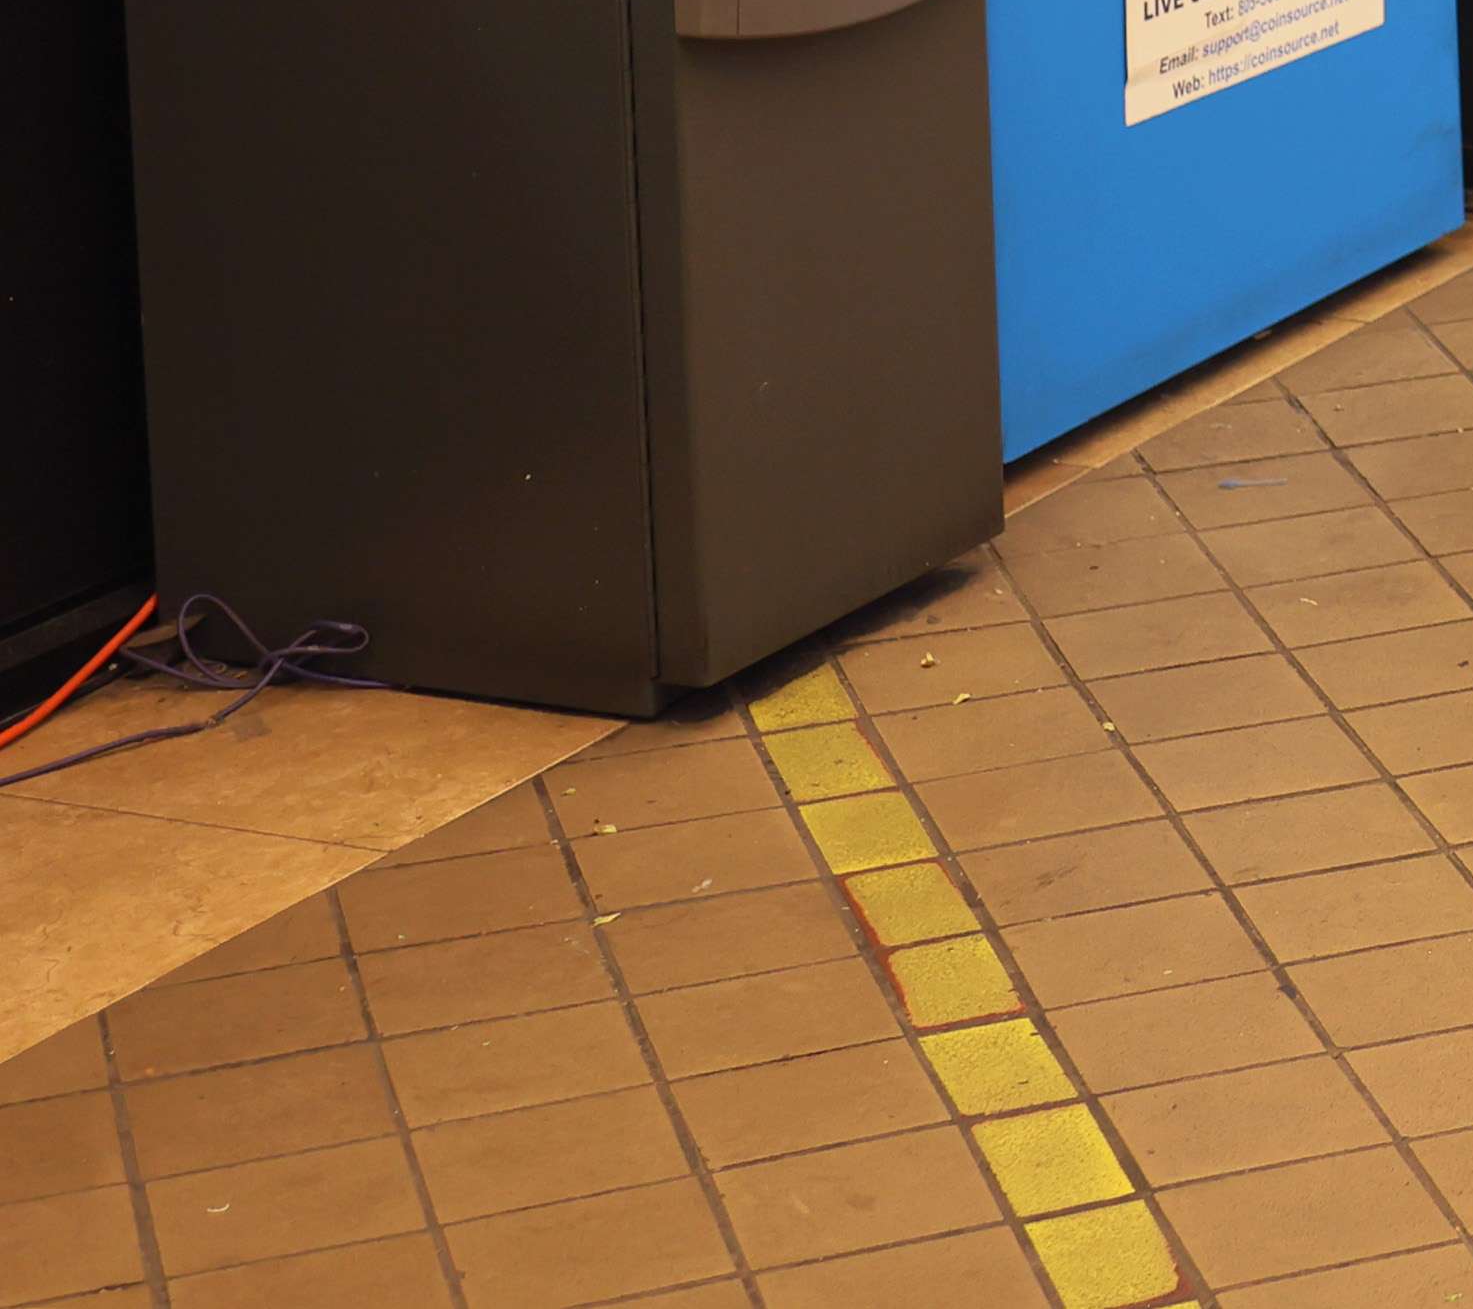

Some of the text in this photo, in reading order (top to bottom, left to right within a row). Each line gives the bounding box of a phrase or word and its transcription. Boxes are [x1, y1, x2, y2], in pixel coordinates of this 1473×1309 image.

[1204, 6, 1235, 29] Text:
[1159, 46, 1199, 75] Email:
[1171, 21, 1340, 99] Web: https://coinsource.net
